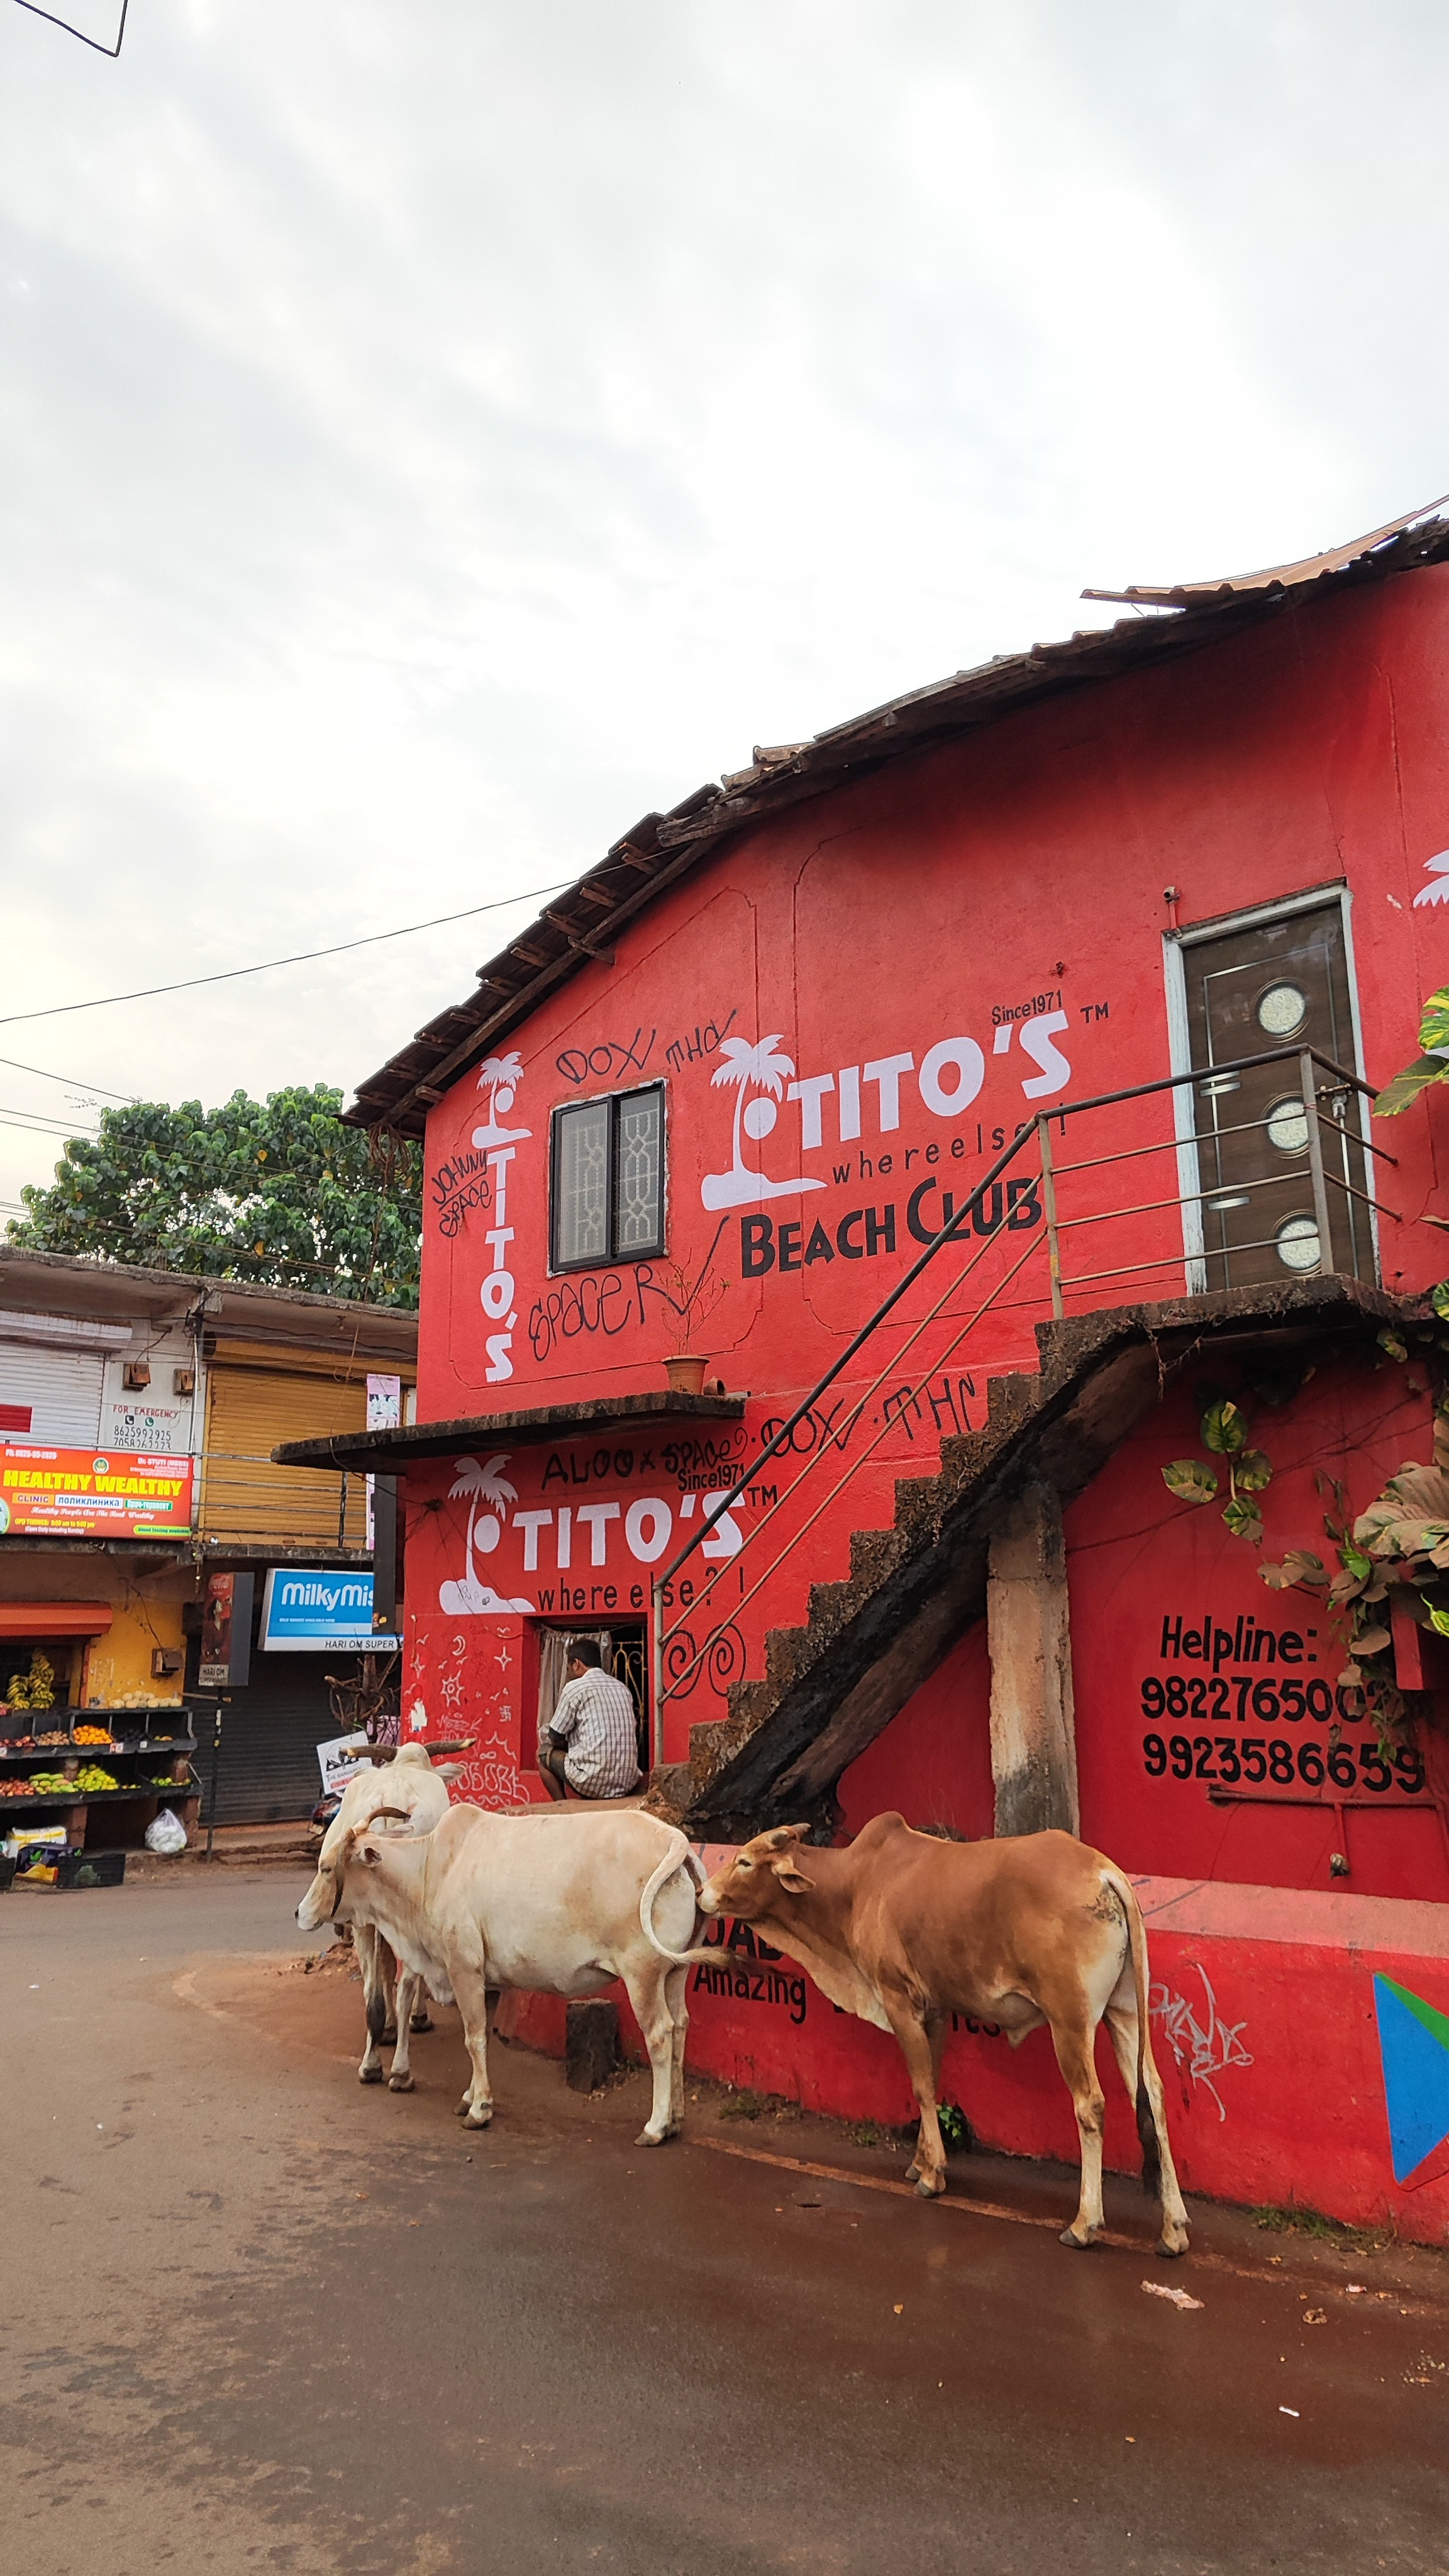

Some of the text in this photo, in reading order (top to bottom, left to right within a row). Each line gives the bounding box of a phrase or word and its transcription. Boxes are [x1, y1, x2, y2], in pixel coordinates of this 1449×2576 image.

[787, 1002, 1109, 1150] TITO'S TM
[740, 1176, 1043, 1278] BEACH CLUB
[480, 1146, 516, 1382] TITO'S
[113, 1404, 179, 1419] FOR EMERGENCY
[3, 1470, 183, 1497] HEALTHY WEALTHY
[18, 1495, 49, 1503] CLINIC
[512, 1485, 777, 1570] TITO'S TM
[538, 1577, 617, 1611] where
[325, 1640, 347, 1648] HARI
[349, 1640, 362, 1648] OM
[365, 1640, 394, 1648] SUPER
[1160, 1615, 1318, 1673] Helpline:
[693, 1963, 807, 2024] Amazing
